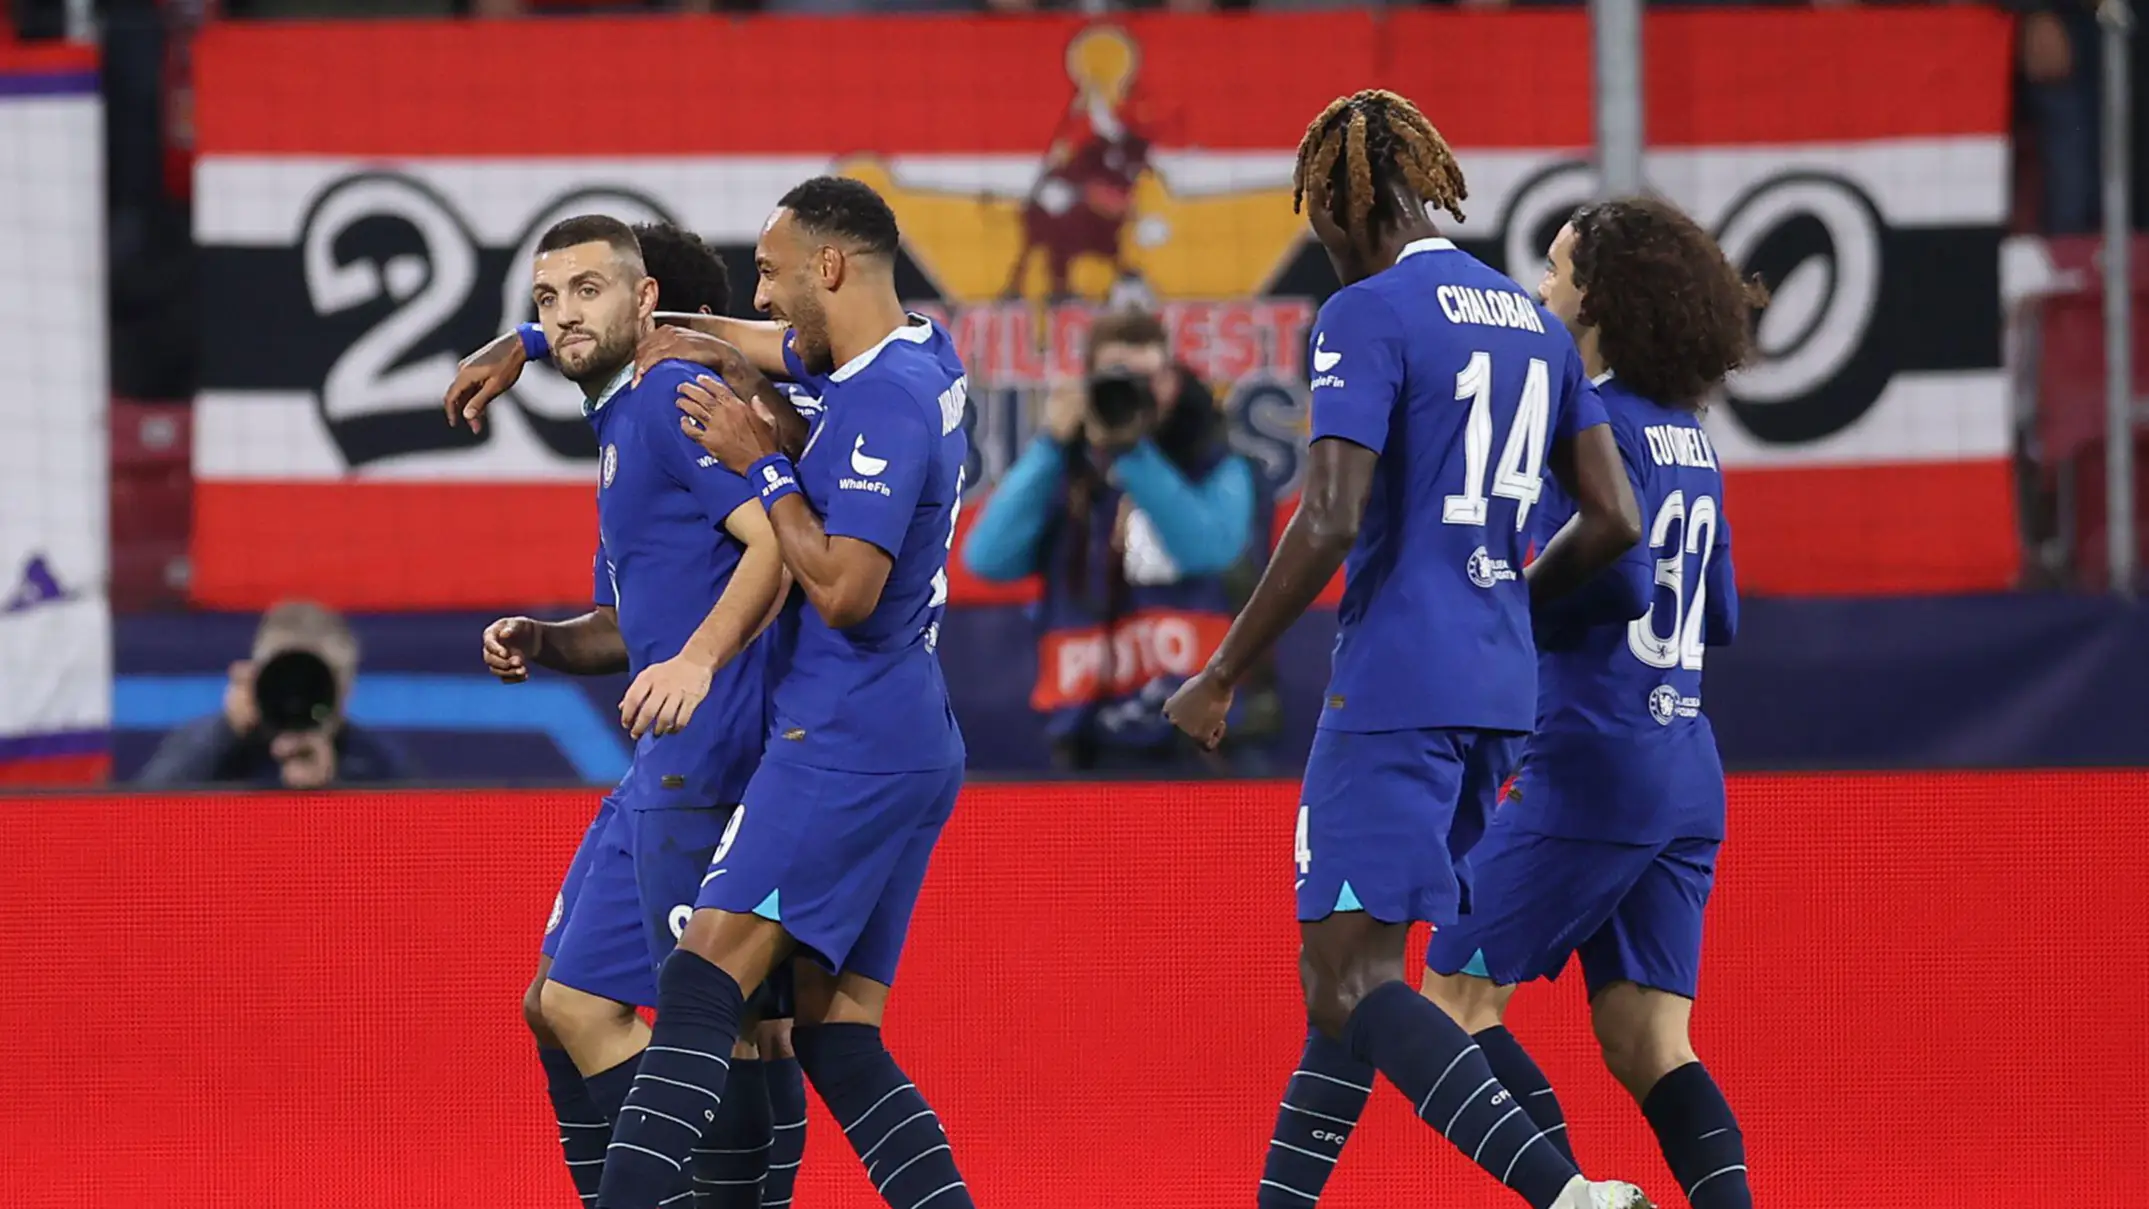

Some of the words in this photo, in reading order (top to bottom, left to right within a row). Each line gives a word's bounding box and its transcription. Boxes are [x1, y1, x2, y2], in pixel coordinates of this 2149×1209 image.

[1436, 285, 1545, 334] CHALOBAH
[1442, 351, 1549, 532] 14
[839, 478, 891, 497] WhaleFin
[1627, 490, 1717, 670] 32
[712, 804, 746, 865] 9
[1311, 1129, 1345, 1145] CFC
